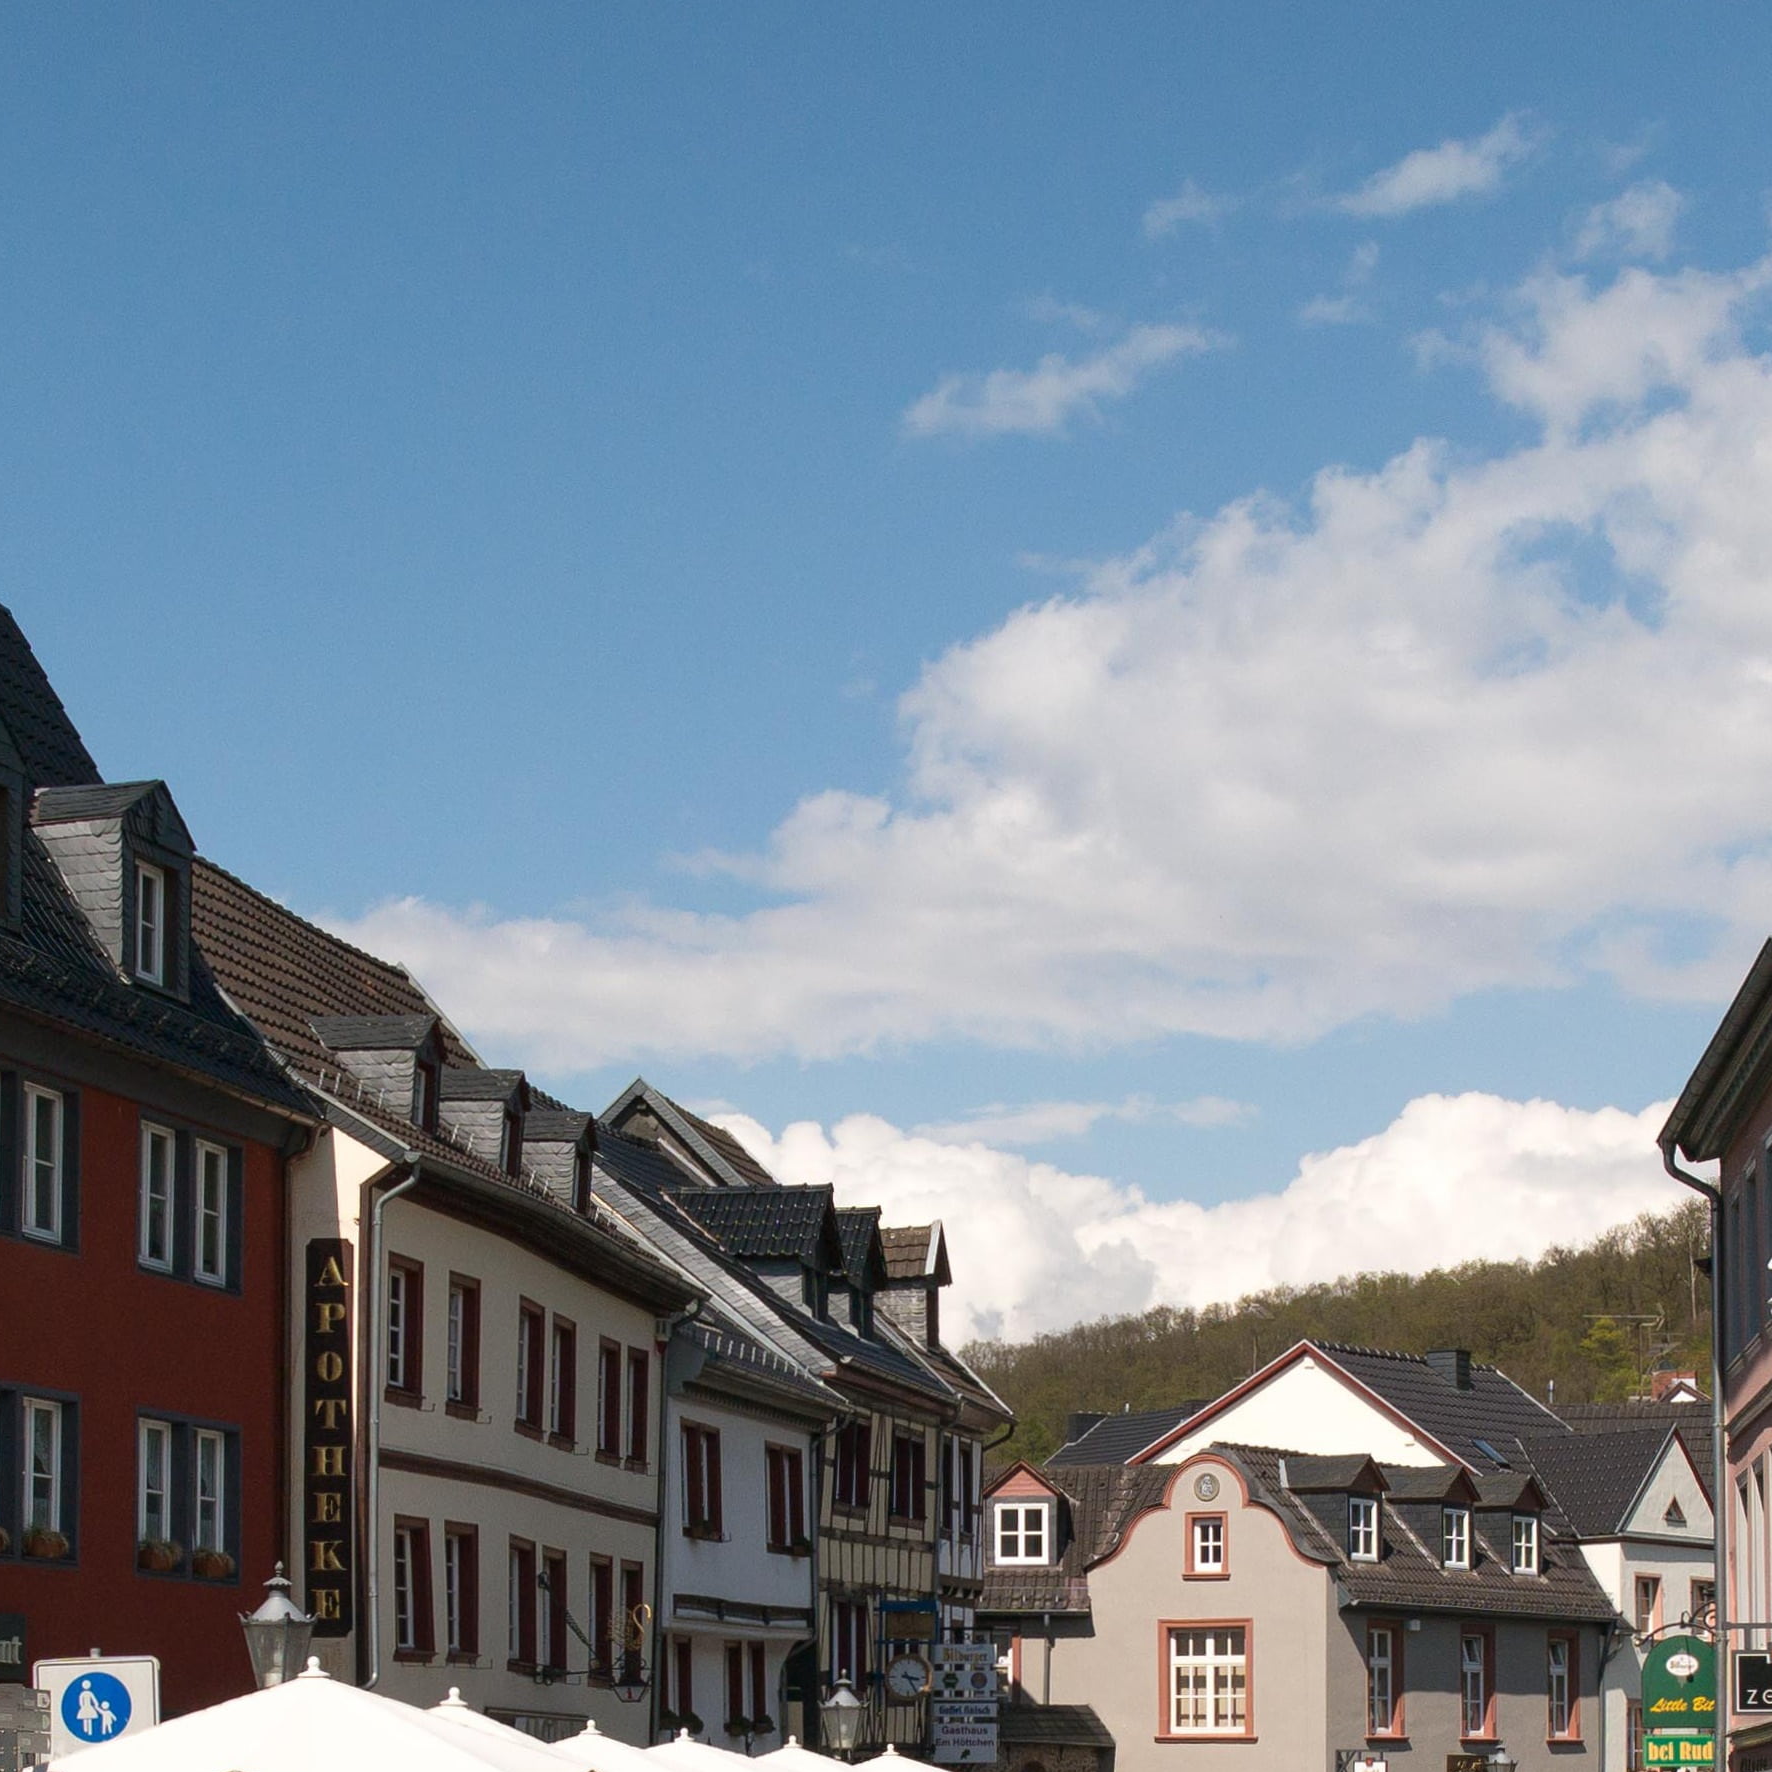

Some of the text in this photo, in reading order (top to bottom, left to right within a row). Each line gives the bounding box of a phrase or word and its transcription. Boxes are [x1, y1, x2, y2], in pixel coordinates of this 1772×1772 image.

[311, 1255, 349, 1620] APOTHEKE
[1650, 1696, 1716, 1713] Little Bit
[941, 1726, 988, 1736] Gasthaus
[953, 1737, 995, 1747] Höttchen
[1679, 1741, 1715, 1761] Rud
